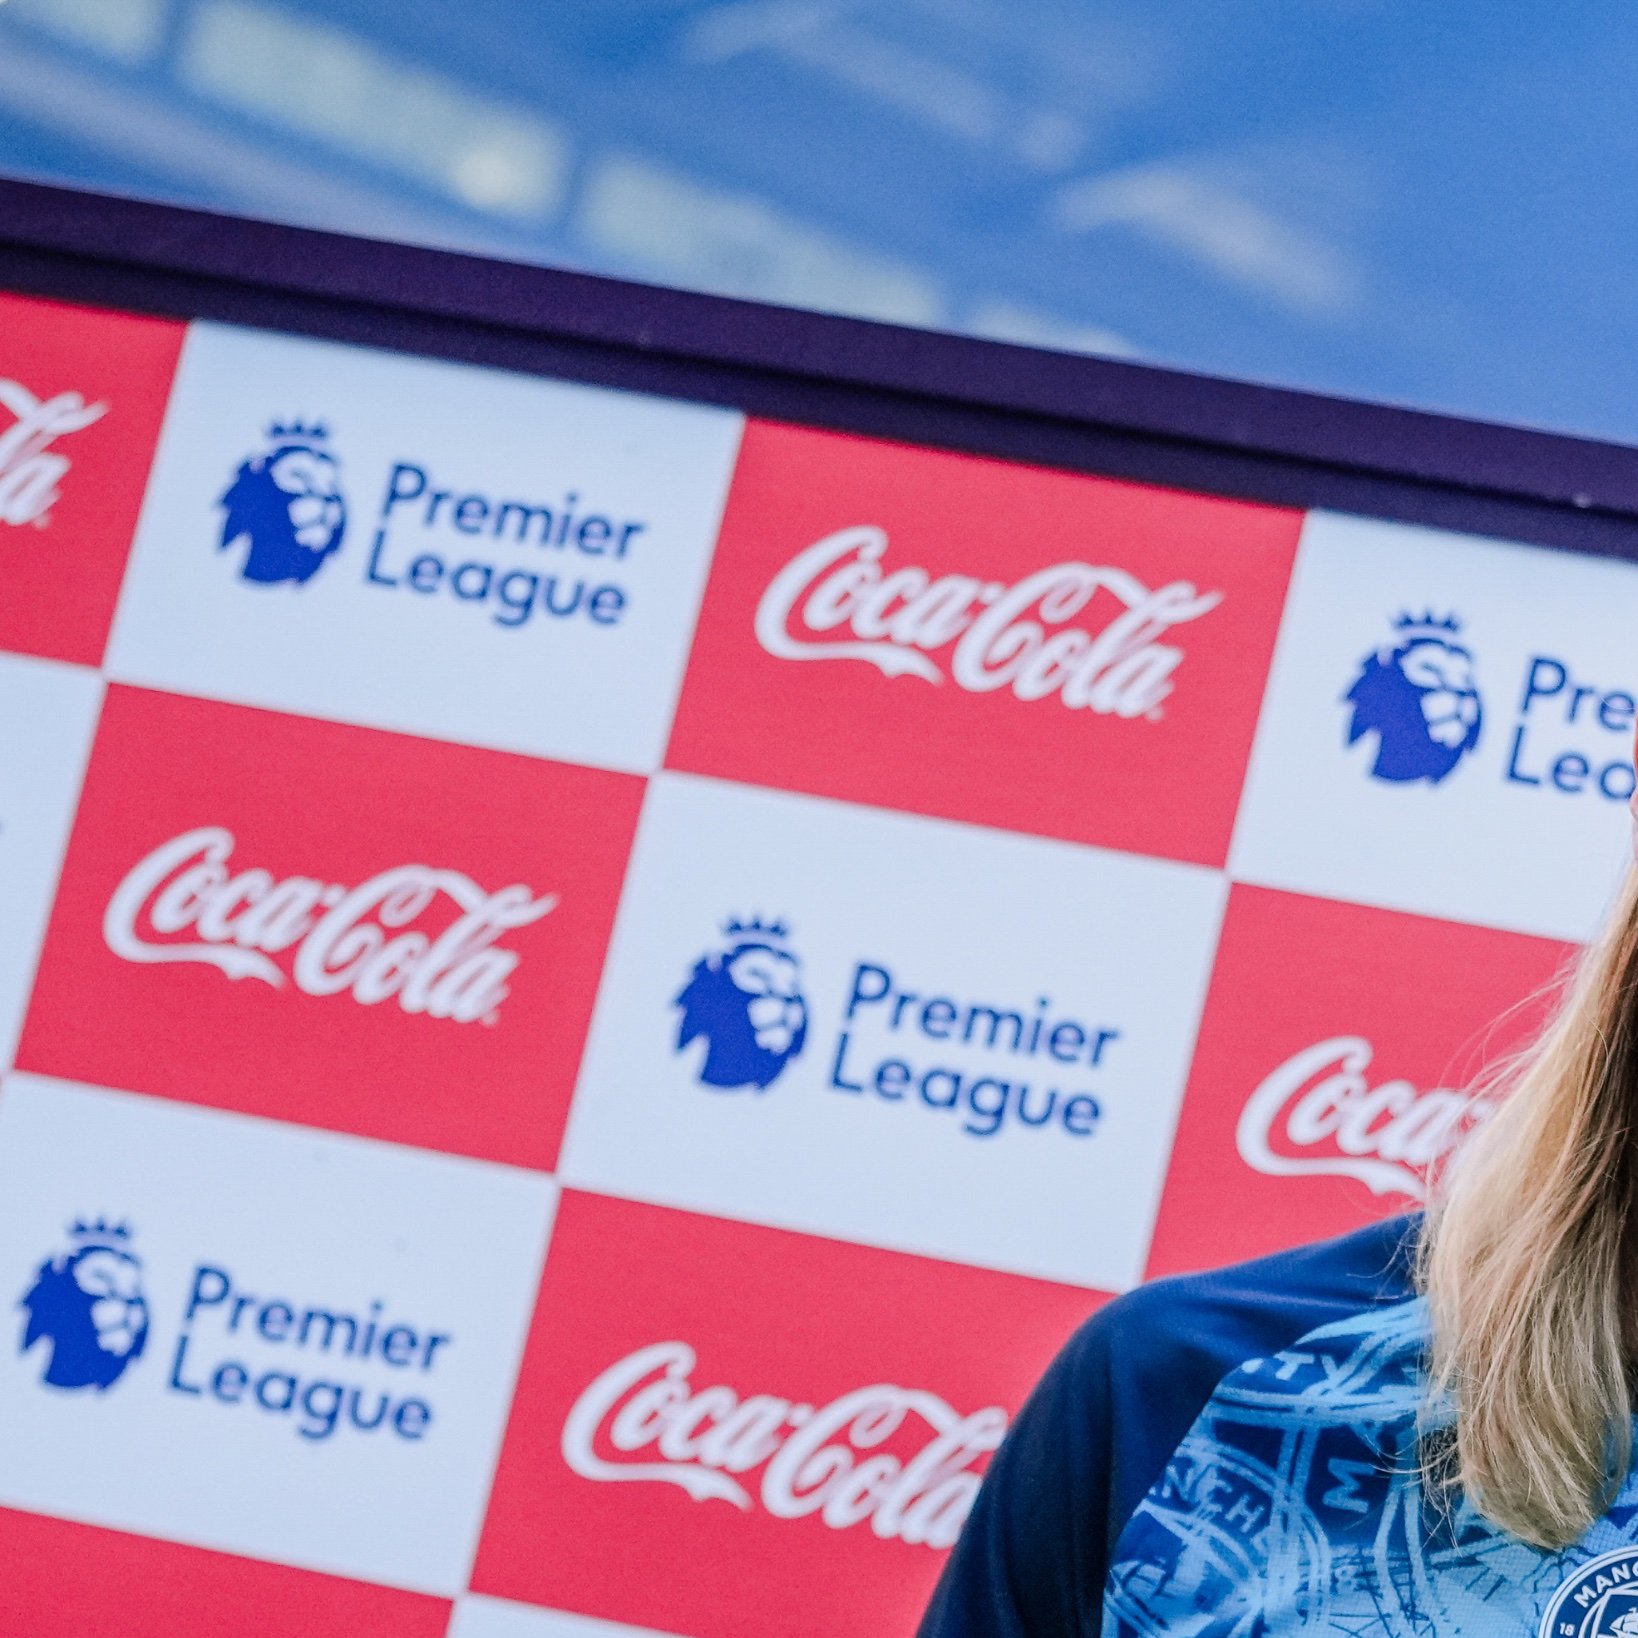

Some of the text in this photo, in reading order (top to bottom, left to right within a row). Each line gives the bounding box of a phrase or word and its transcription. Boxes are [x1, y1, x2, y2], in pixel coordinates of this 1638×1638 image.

[383, 463, 643, 556] Premier
[367, 530, 625, 627] League
[755, 527, 1222, 719] Coca-Cola
[1506, 725, 1636, 800] Lea
[104, 828, 555, 1024] Coca-Cola
[846, 963, 1118, 1066] Premier
[830, 1032, 1101, 1137] League
[185, 1266, 448, 1369] Premier
[169, 1334, 431, 1440] League
[1559, 1622, 1576, 1637] 18
